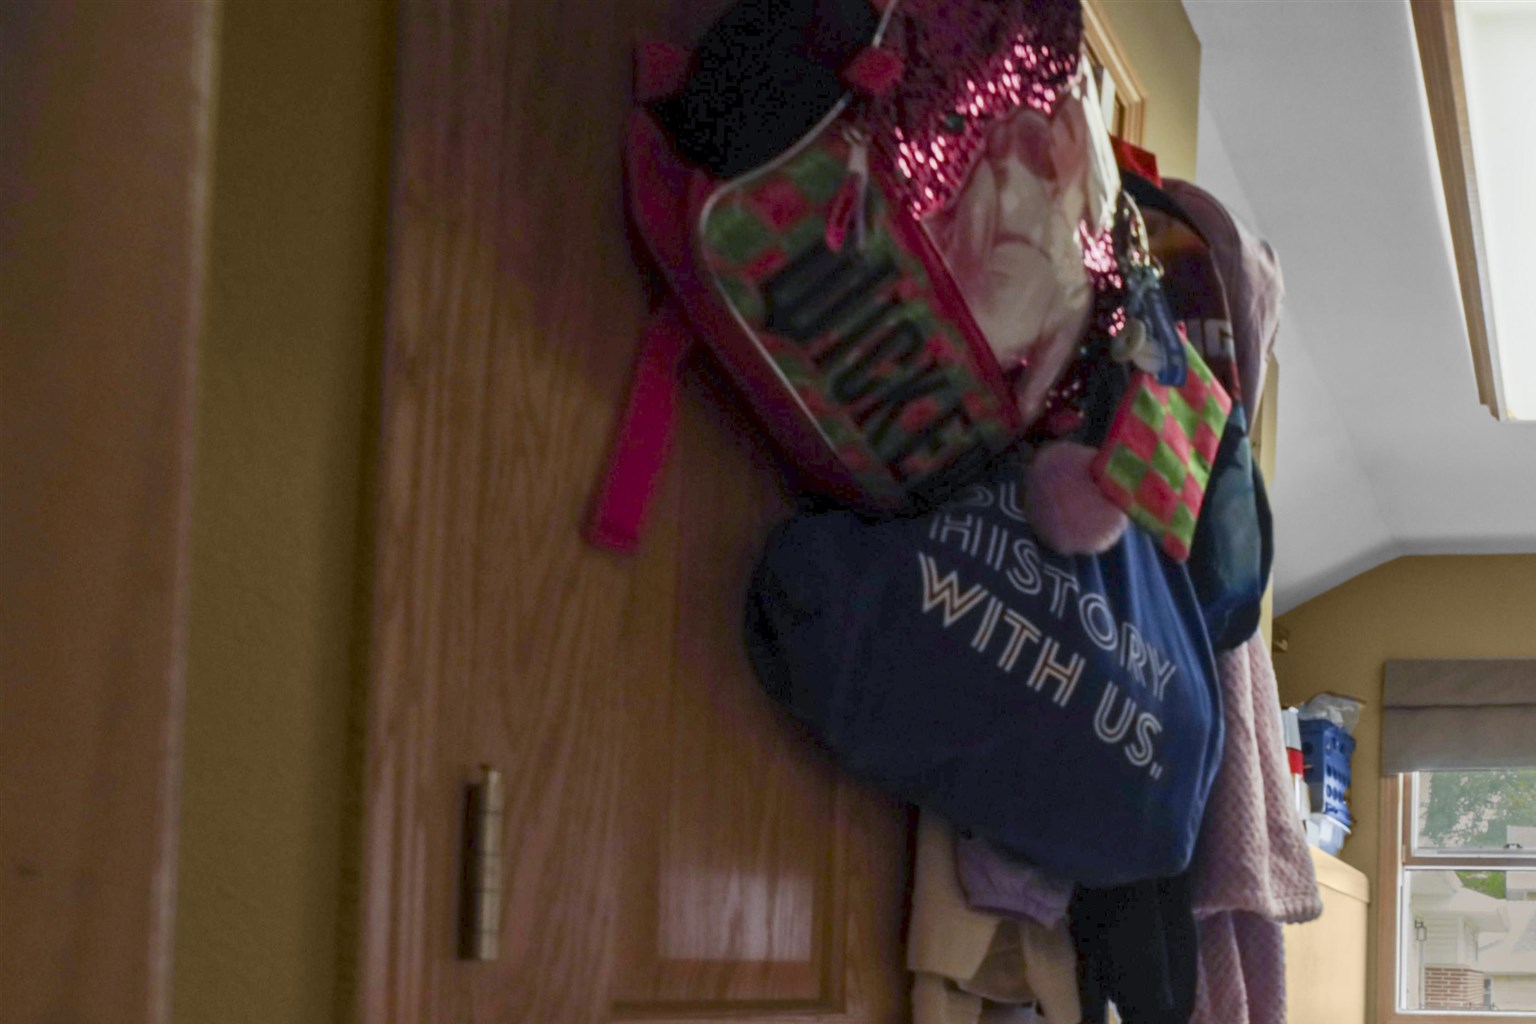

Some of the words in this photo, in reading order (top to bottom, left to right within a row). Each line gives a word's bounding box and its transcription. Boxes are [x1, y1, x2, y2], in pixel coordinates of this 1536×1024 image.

[762, 236, 988, 486] WICKE
[918, 551, 1087, 708] WITH
[928, 512, 1178, 704] HISTORY
